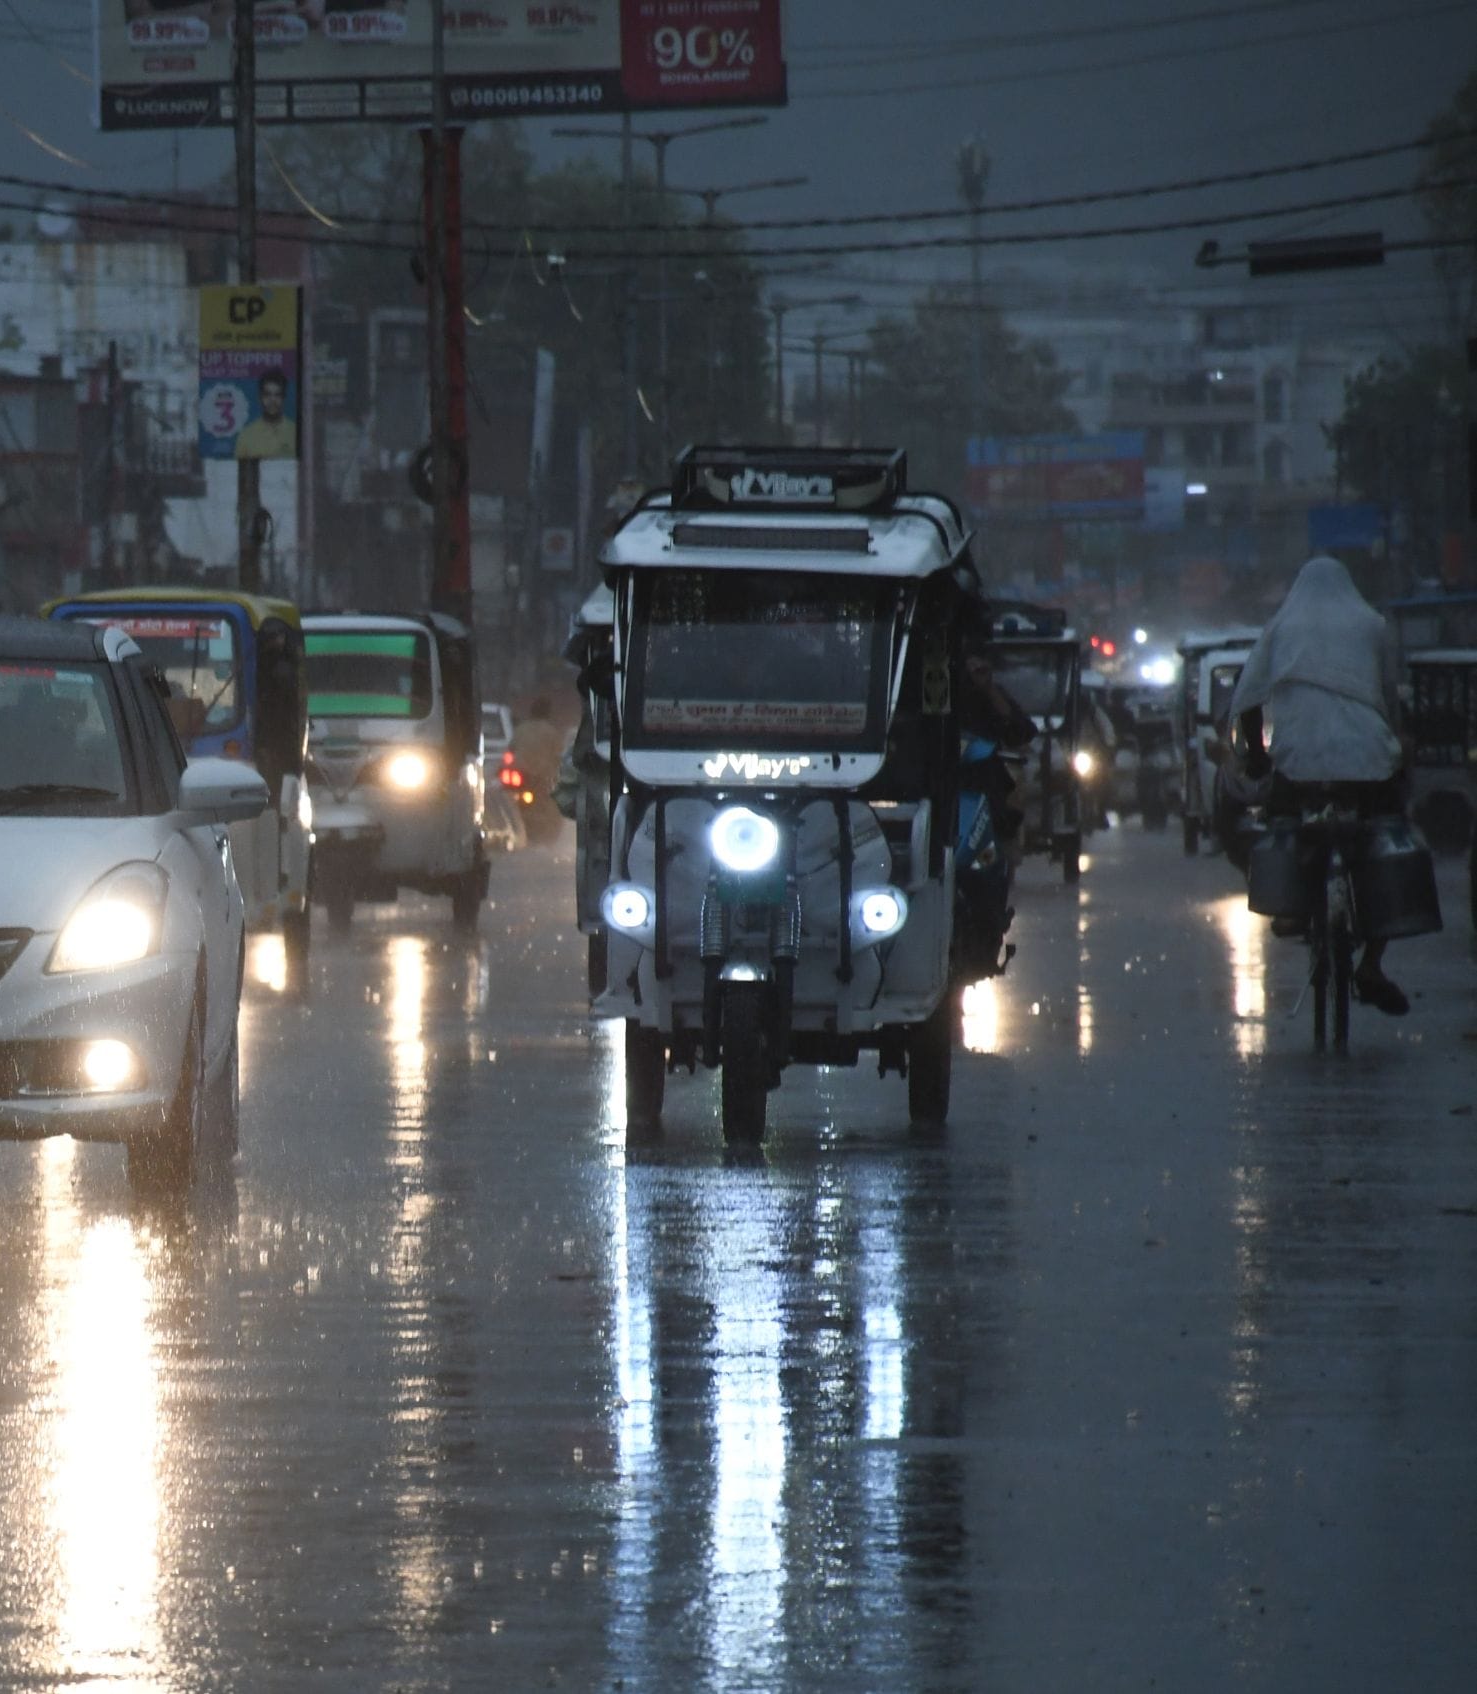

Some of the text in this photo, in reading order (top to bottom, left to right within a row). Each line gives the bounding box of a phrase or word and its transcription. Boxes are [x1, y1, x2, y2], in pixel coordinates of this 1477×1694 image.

[653, 24, 755, 69] 90%
[660, 69, 750, 85] SCHOLARSHIP
[127, 98, 209, 116] LUCKNOW
[228, 295, 266, 324] CP
[201, 351, 284, 367] UP TOPPER
[212, 400, 236, 433] 3
